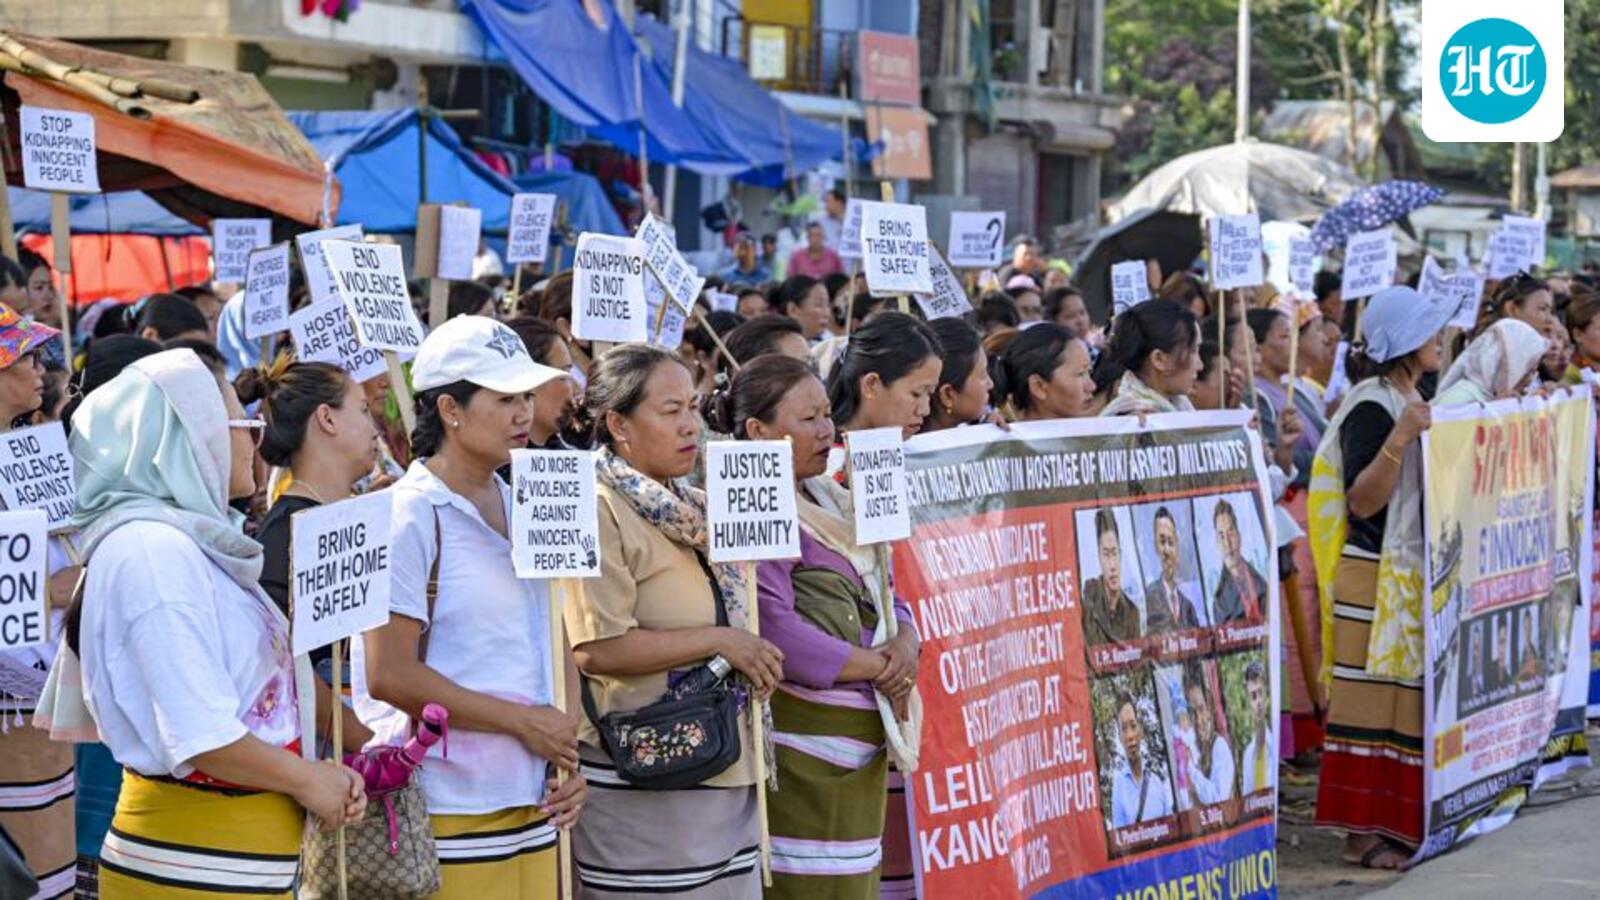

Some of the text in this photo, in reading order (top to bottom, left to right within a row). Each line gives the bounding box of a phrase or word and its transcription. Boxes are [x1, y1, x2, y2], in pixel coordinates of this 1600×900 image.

[41, 116, 72, 132] STOP
[25, 134, 92, 153] KIDNAPPING
[32, 151, 87, 167] INNOCENT
[40, 167, 84, 183] PEOPLE
[879, 220, 912, 238] BRING
[352, 247, 381, 269] END
[866, 238, 928, 257] THEM HOME
[575, 251, 641, 275] KIDNAPPING
[880, 258, 918, 275] SAFELY
[341, 271, 404, 298] VIOLENCE
[590, 274, 624, 296] IS NOT
[354, 297, 406, 322] AGAINST
[586, 298, 631, 319] JUSTICE
[304, 305, 350, 337] HOSTA
[303, 333, 332, 359] ARE
[362, 322, 420, 347] CIVILIANS
[338, 339, 360, 358] NO
[8, 435, 41, 458] END
[0, 453, 70, 484] VIOLENCE
[531, 456, 579, 474] NO MORE
[720, 453, 781, 480] JUSTICE
[853, 447, 903, 473] KIDNAPPING
[928, 463, 963, 503] NAGA
[1025, 452, 1081, 488] HOSTAGE
[1080, 450, 1097, 483] OF
[1100, 449, 1127, 482] KUKI
[1129, 446, 1176, 481] ARMED
[1177, 440, 1248, 475] MILITANTS
[15, 476, 75, 506] AGAINST
[529, 480, 581, 498] VIOLENCE
[864, 472, 893, 495] IS NOT
[727, 486, 779, 514] PEACE
[864, 495, 899, 519] JUSTICE
[532, 505, 577, 521] AGAINST
[319, 523, 366, 559] BRING
[527, 529, 581, 546] INNOCENT
[714, 520, 793, 549] HUMANITY
[297, 545, 388, 598] THEM HOME
[534, 553, 577, 571] PEOPLE
[312, 581, 370, 622] SAFELY
[1044, 674, 1061, 715] AT
